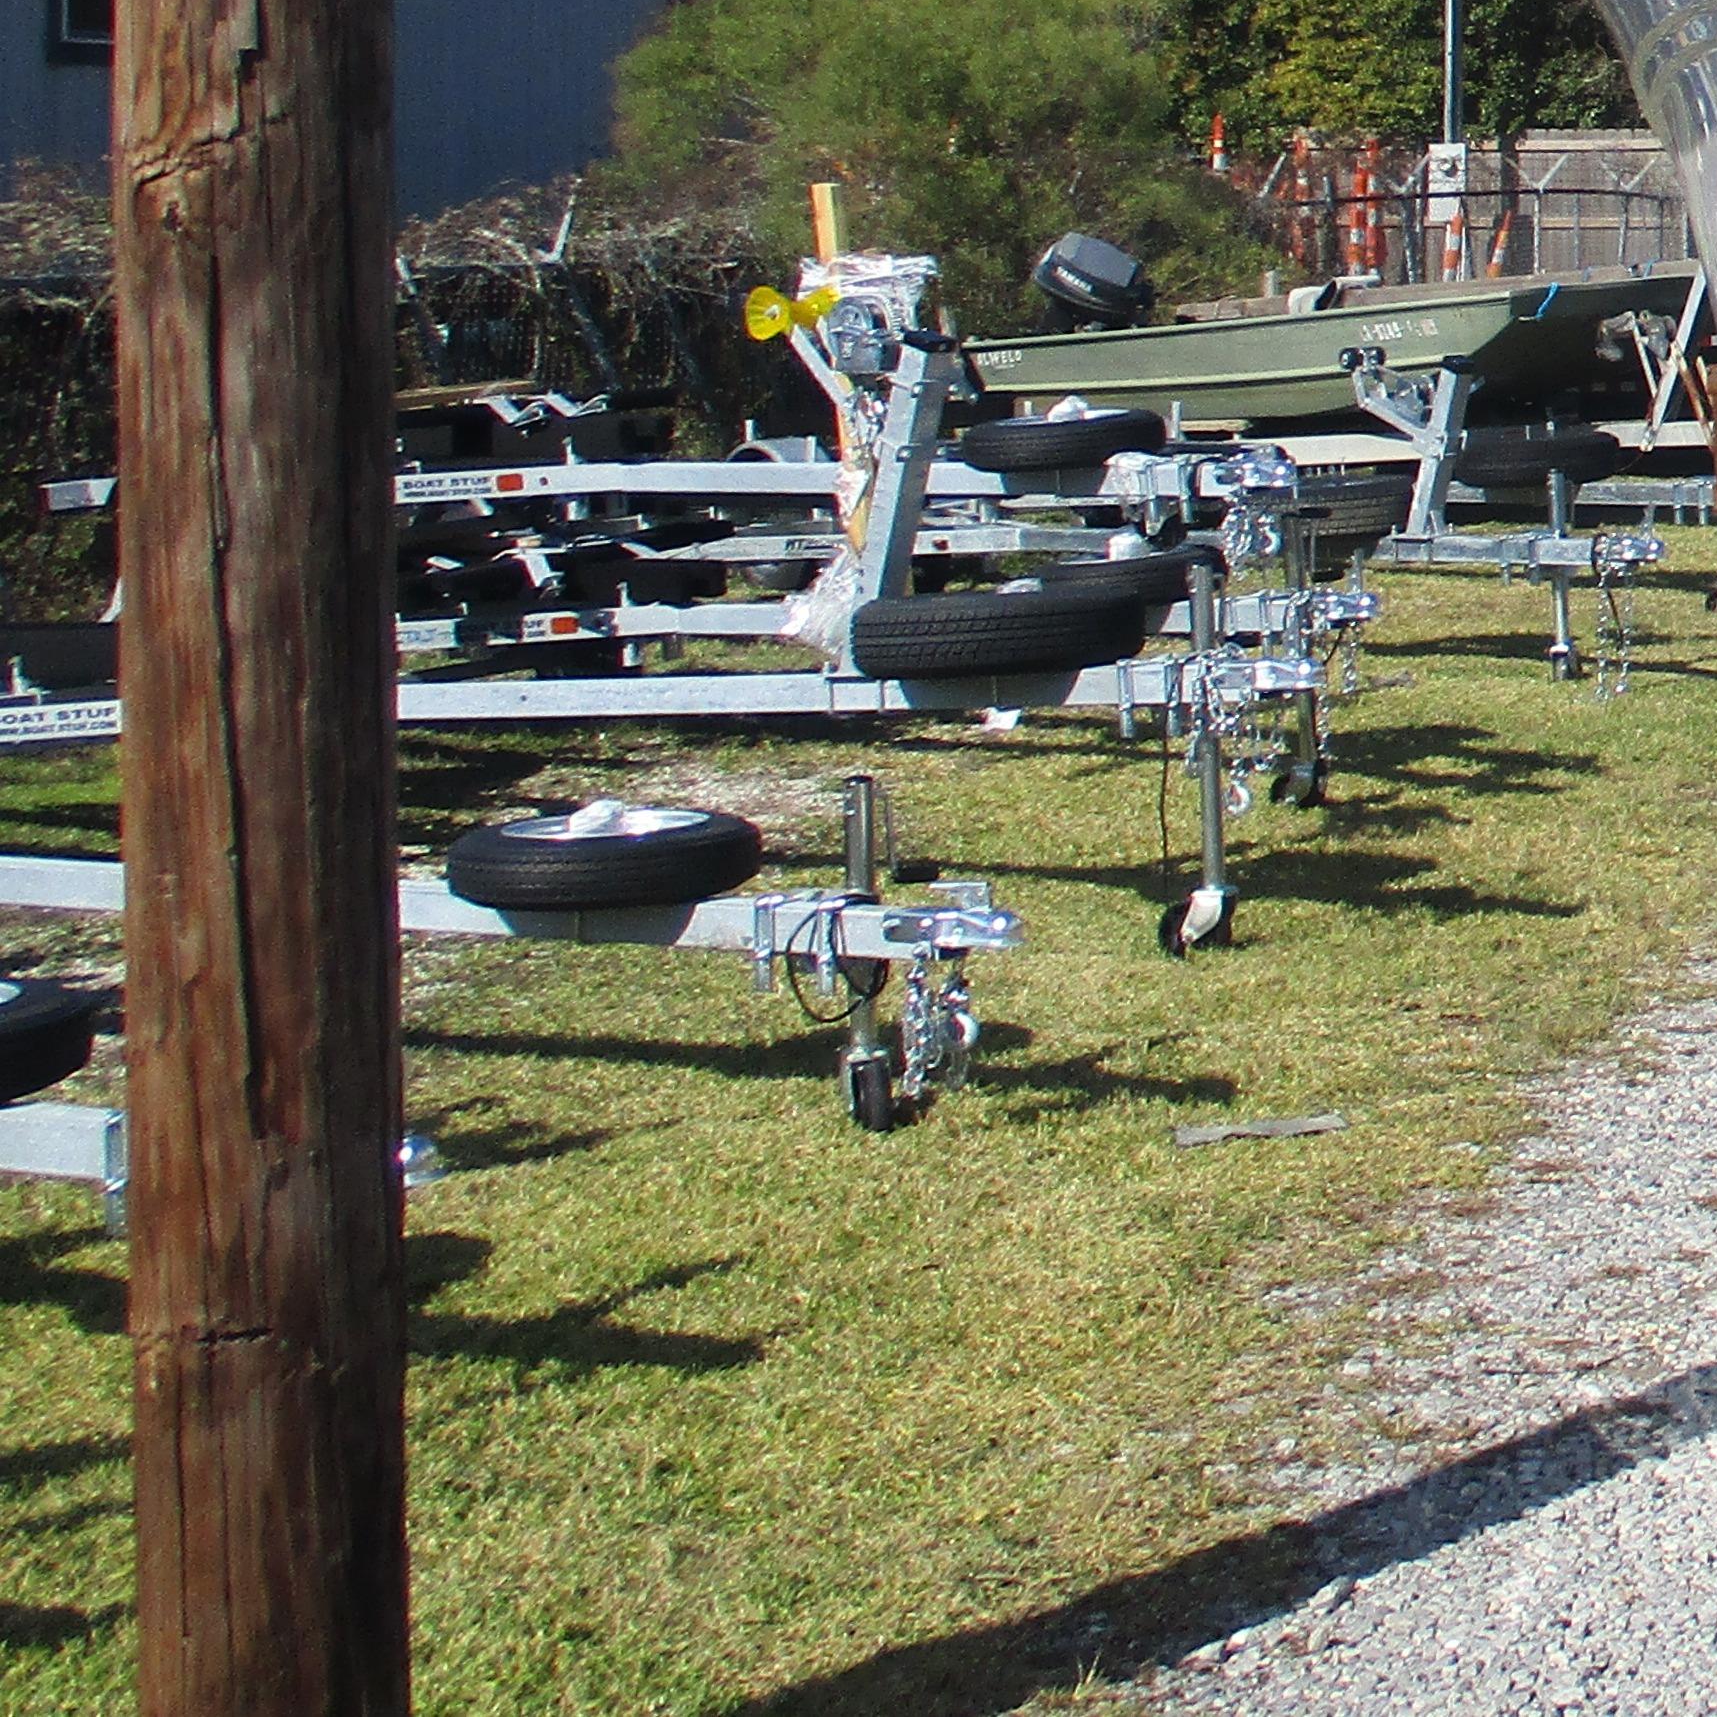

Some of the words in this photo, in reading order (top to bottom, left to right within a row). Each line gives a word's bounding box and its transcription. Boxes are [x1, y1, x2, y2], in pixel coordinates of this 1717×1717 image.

[403, 479, 443, 489] BOAT
[450, 477, 491, 486] STUF
[0, 712, 47, 724] OAT
[57, 707, 116, 720] STUF
